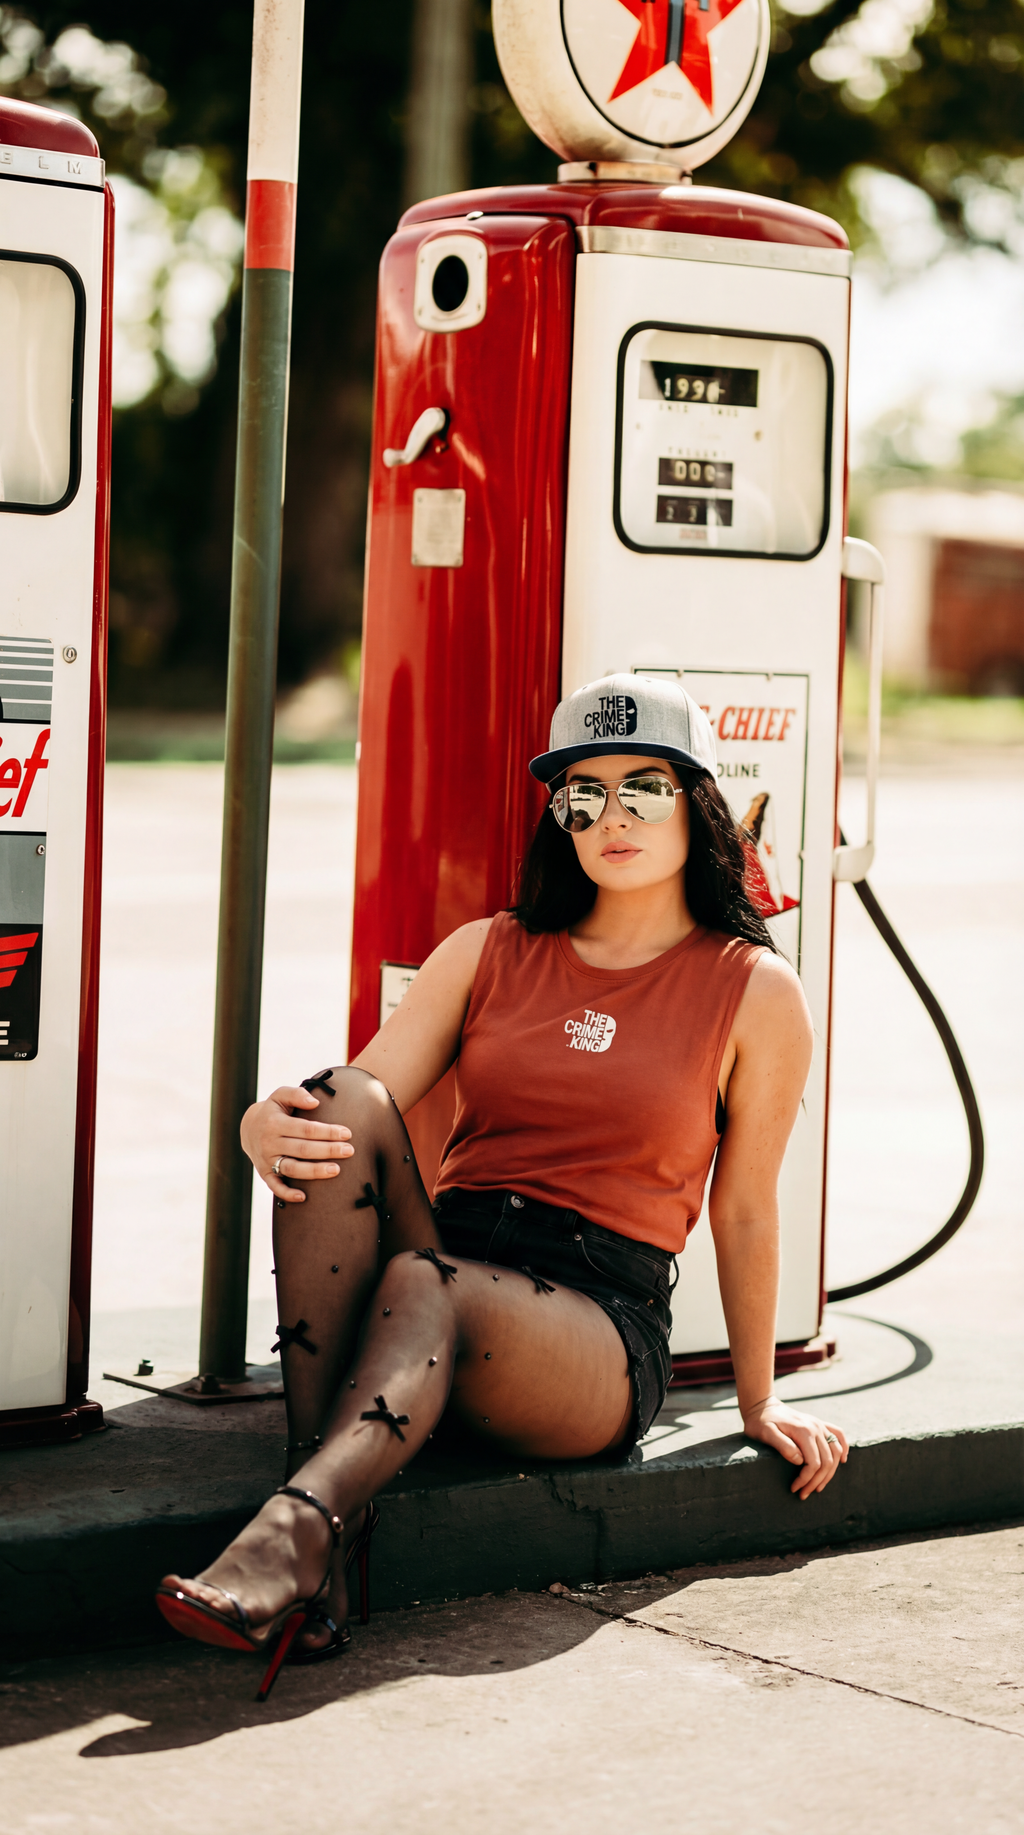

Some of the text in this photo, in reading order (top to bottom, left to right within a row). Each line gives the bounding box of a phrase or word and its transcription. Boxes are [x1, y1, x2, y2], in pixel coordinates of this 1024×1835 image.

[598, 695, 625, 710] THE
[584, 708, 625, 728] CRIME
[584, 1009, 608, 1028] THE
[564, 1019, 605, 1040] CRIME
